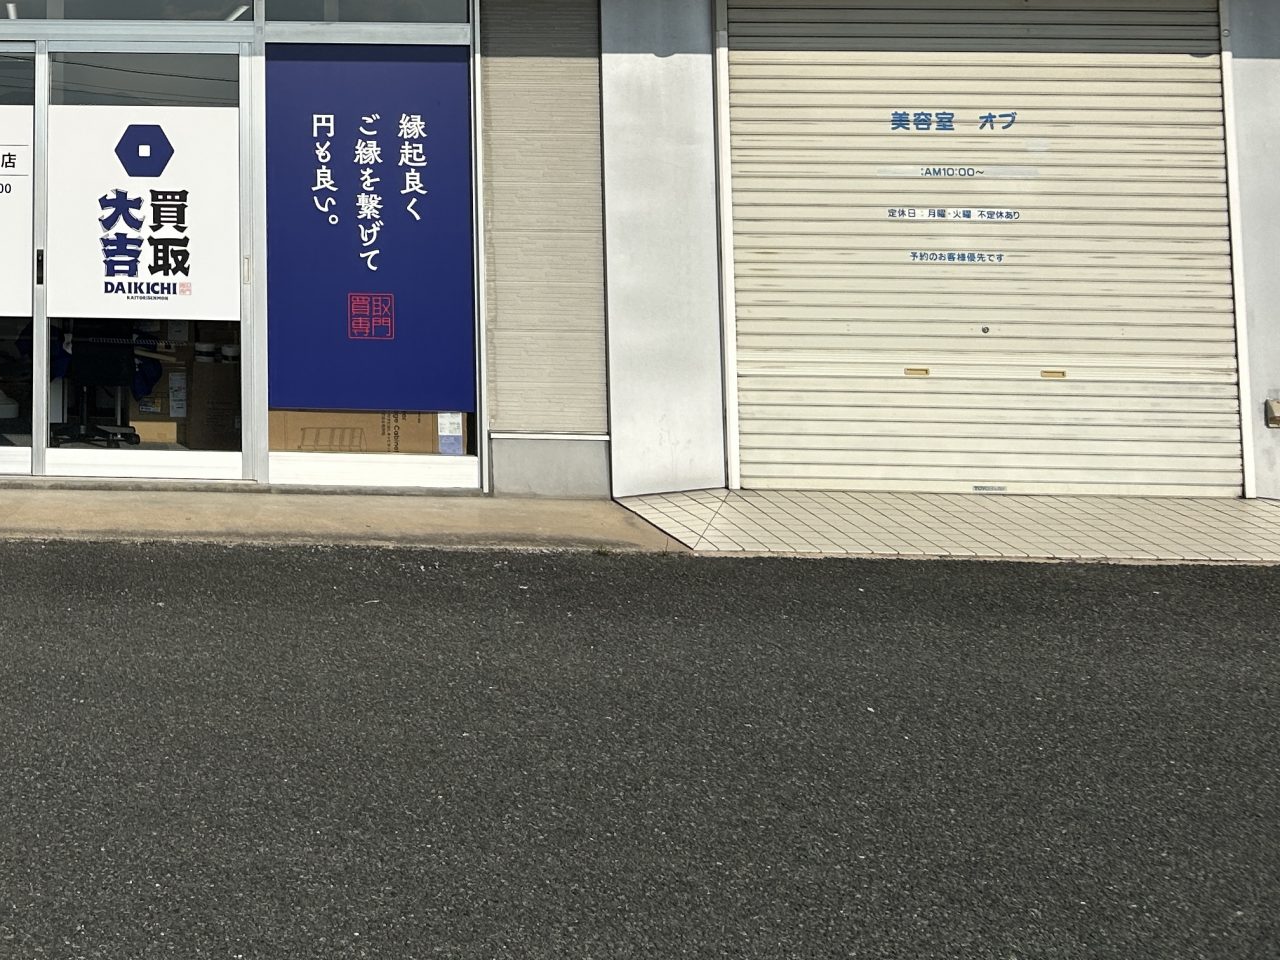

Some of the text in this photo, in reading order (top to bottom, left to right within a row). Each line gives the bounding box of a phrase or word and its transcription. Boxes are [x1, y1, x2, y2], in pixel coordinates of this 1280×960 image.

[891, 111, 1017, 131] 美容室 オブ
[311, 113, 339, 225] 円も良い。
[354, 113, 384, 271] ご縁を繋げて
[398, 113, 428, 221] 縁起良く
[98, 188, 146, 278] 大吉
[147, 189, 191, 277] 買取
[910, 251, 1004, 263] 予約のお客様優先です
[104, 281, 177, 295] DAIKICHI
